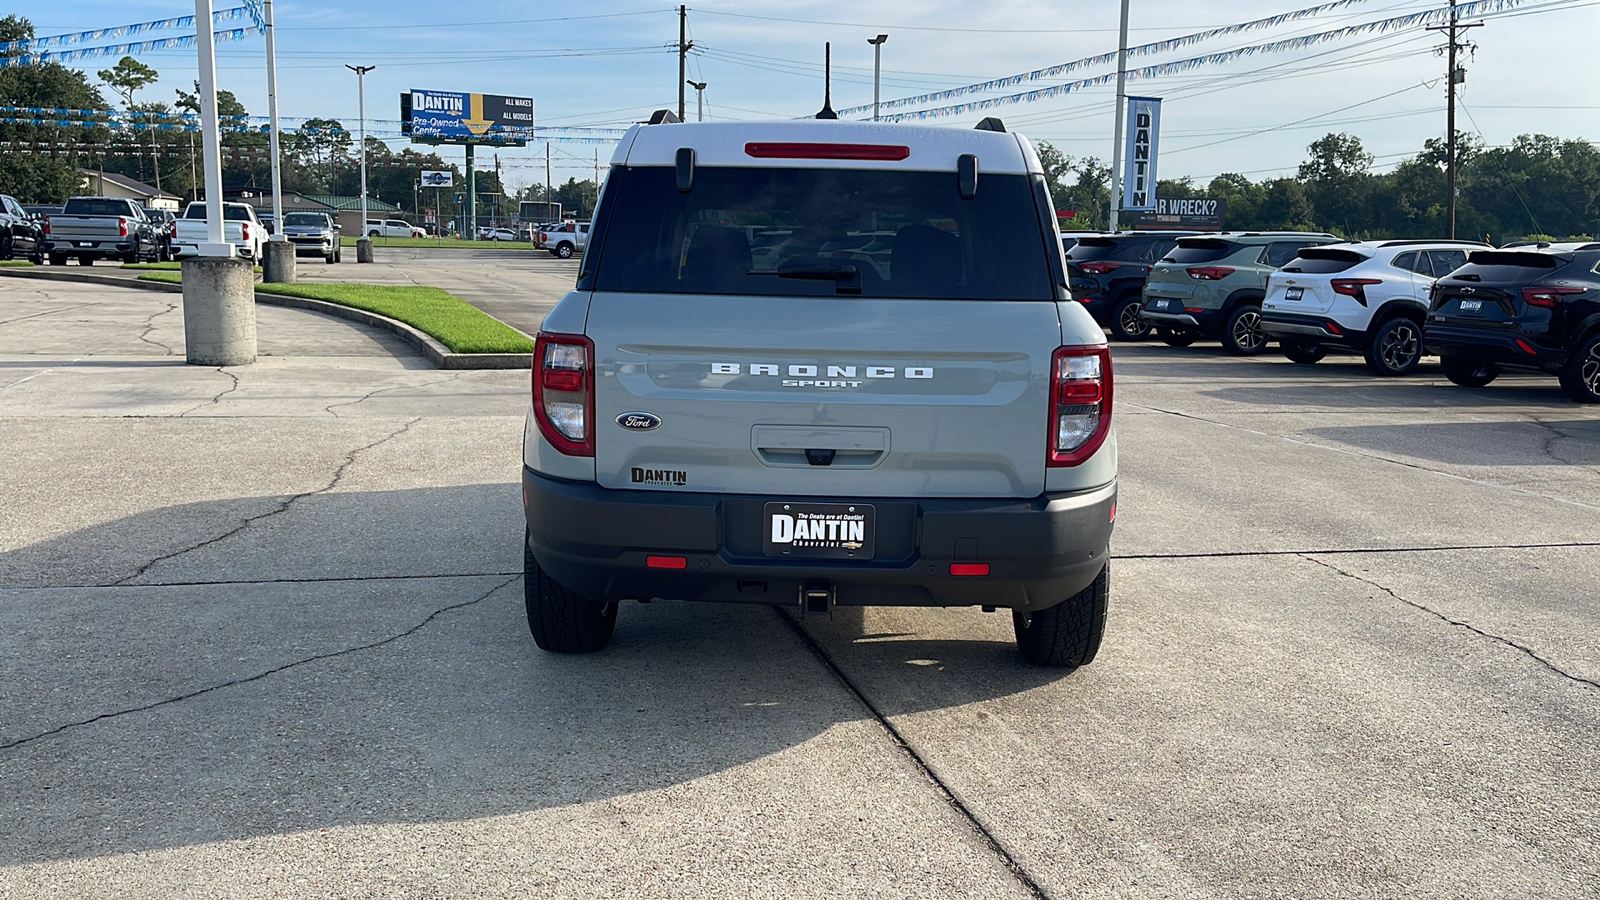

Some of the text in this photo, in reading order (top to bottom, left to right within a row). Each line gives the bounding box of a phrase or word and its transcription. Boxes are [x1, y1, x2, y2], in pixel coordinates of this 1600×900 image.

[412, 92, 463, 111] DANTIN
[505, 98, 532, 107] ALL MAKES
[413, 116, 460, 128] Pre-Owned
[503, 112, 532, 121] ALL MODELS
[413, 126, 442, 135] Center
[1132, 113, 1150, 207] DANTIN
[1169, 199, 1217, 215] WRECK?
[1460, 300, 1482, 310] DANTIN
[711, 362, 934, 379] BRONCO
[782, 379, 863, 388] SPORT
[625, 415, 651, 428] Ford
[631, 467, 687, 483] DANTIN
[771, 514, 865, 543] DANTIN
[792, 540, 839, 548] Chevrolet
